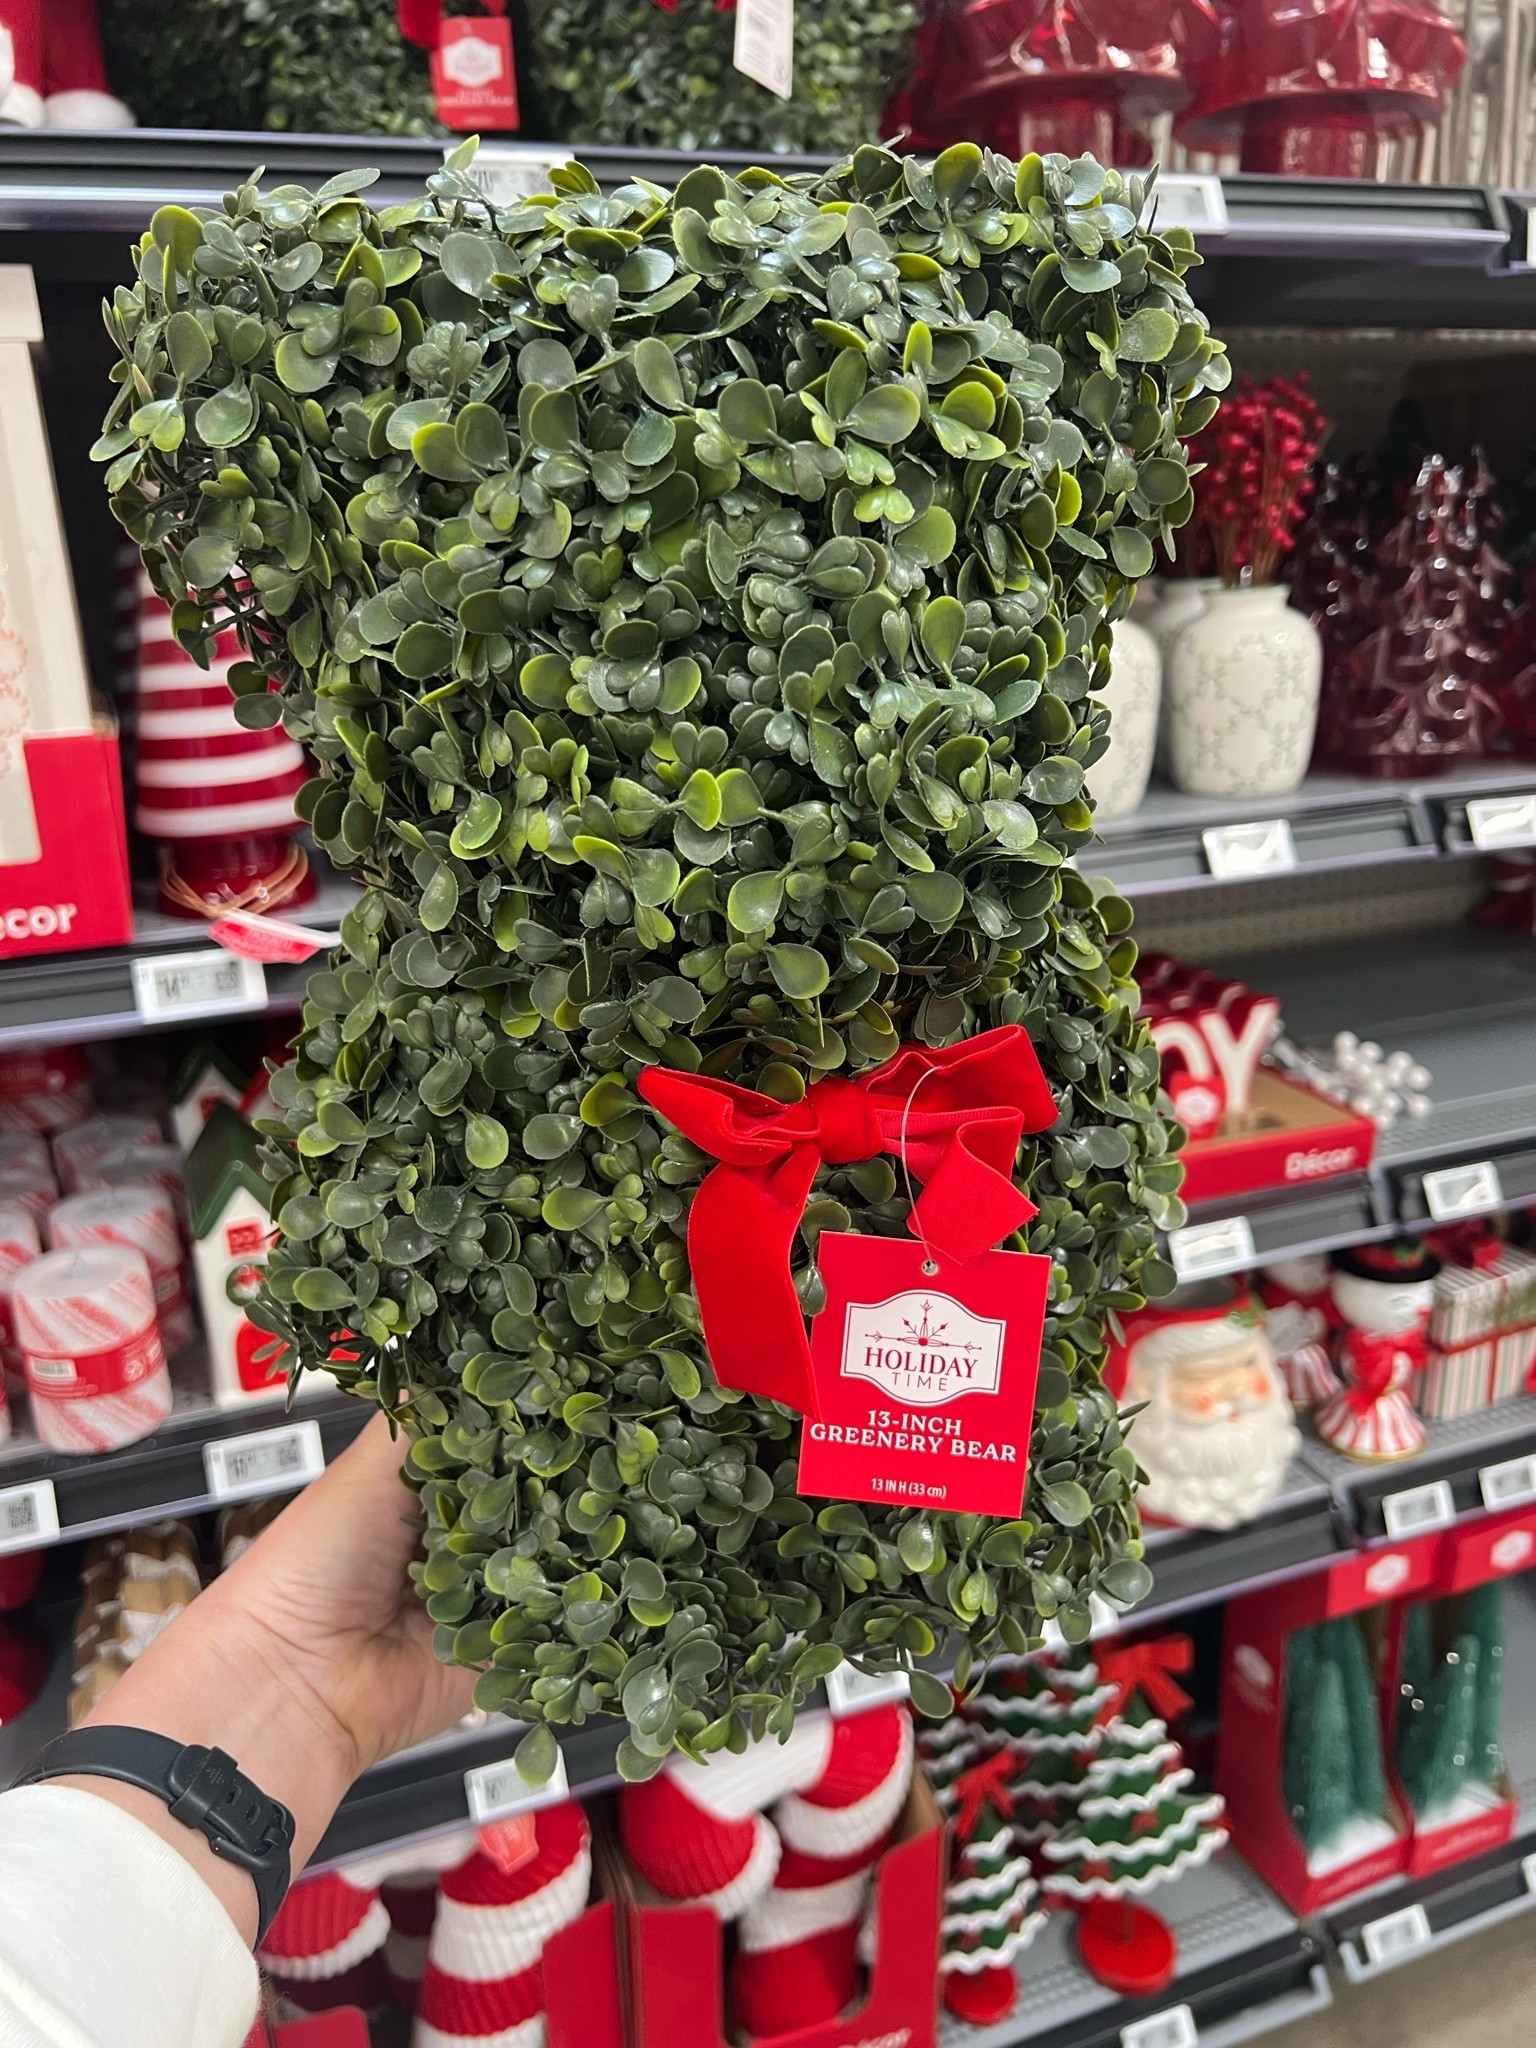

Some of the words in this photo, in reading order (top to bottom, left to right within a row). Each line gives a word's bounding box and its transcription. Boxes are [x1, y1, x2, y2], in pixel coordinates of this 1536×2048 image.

[0, 902, 77, 940] cor
[864, 1347, 978, 1378] HOLIDAY
[892, 1372, 948, 1391] TIME
[868, 1410, 962, 1435] 13-INCH
[809, 1423, 943, 1453] GREENERY
[950, 1438, 1016, 1462] BEAR
[871, 1477, 883, 1491] 13
[885, 1479, 897, 1493] IN
[898, 1481, 907, 1493] H
[908, 1481, 925, 1496] (33
[927, 1485, 947, 1499] cm)
